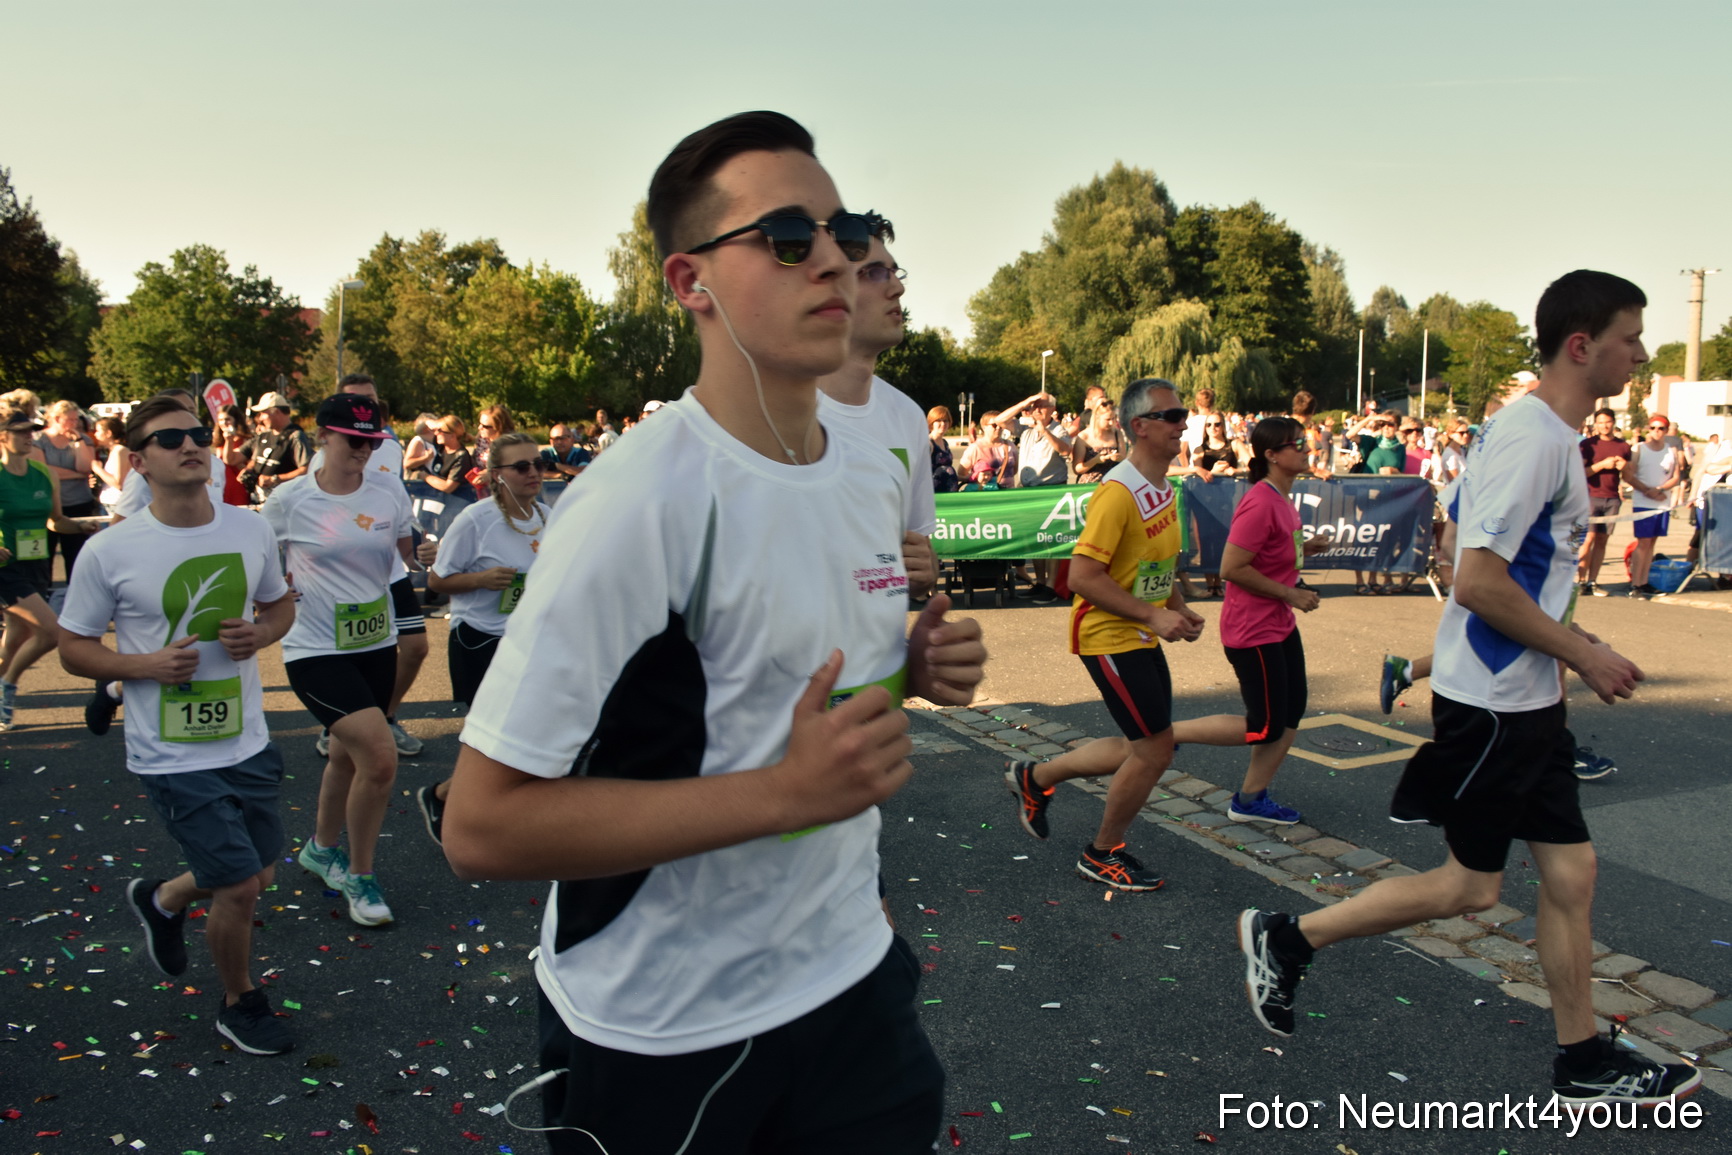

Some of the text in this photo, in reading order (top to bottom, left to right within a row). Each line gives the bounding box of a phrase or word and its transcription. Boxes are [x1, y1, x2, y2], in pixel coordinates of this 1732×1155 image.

[353, 421, 374, 430] adidas
[929, 517, 1012, 540] änden
[1145, 515, 1170, 539] MAX
[1037, 532, 1053, 543] Die
[32, 540, 39, 551] 2
[1311, 547, 1378, 558] MOBILE
[875, 553, 897, 564] TEAM
[344, 613, 385, 637] 1009
[181, 701, 228, 725] 159
